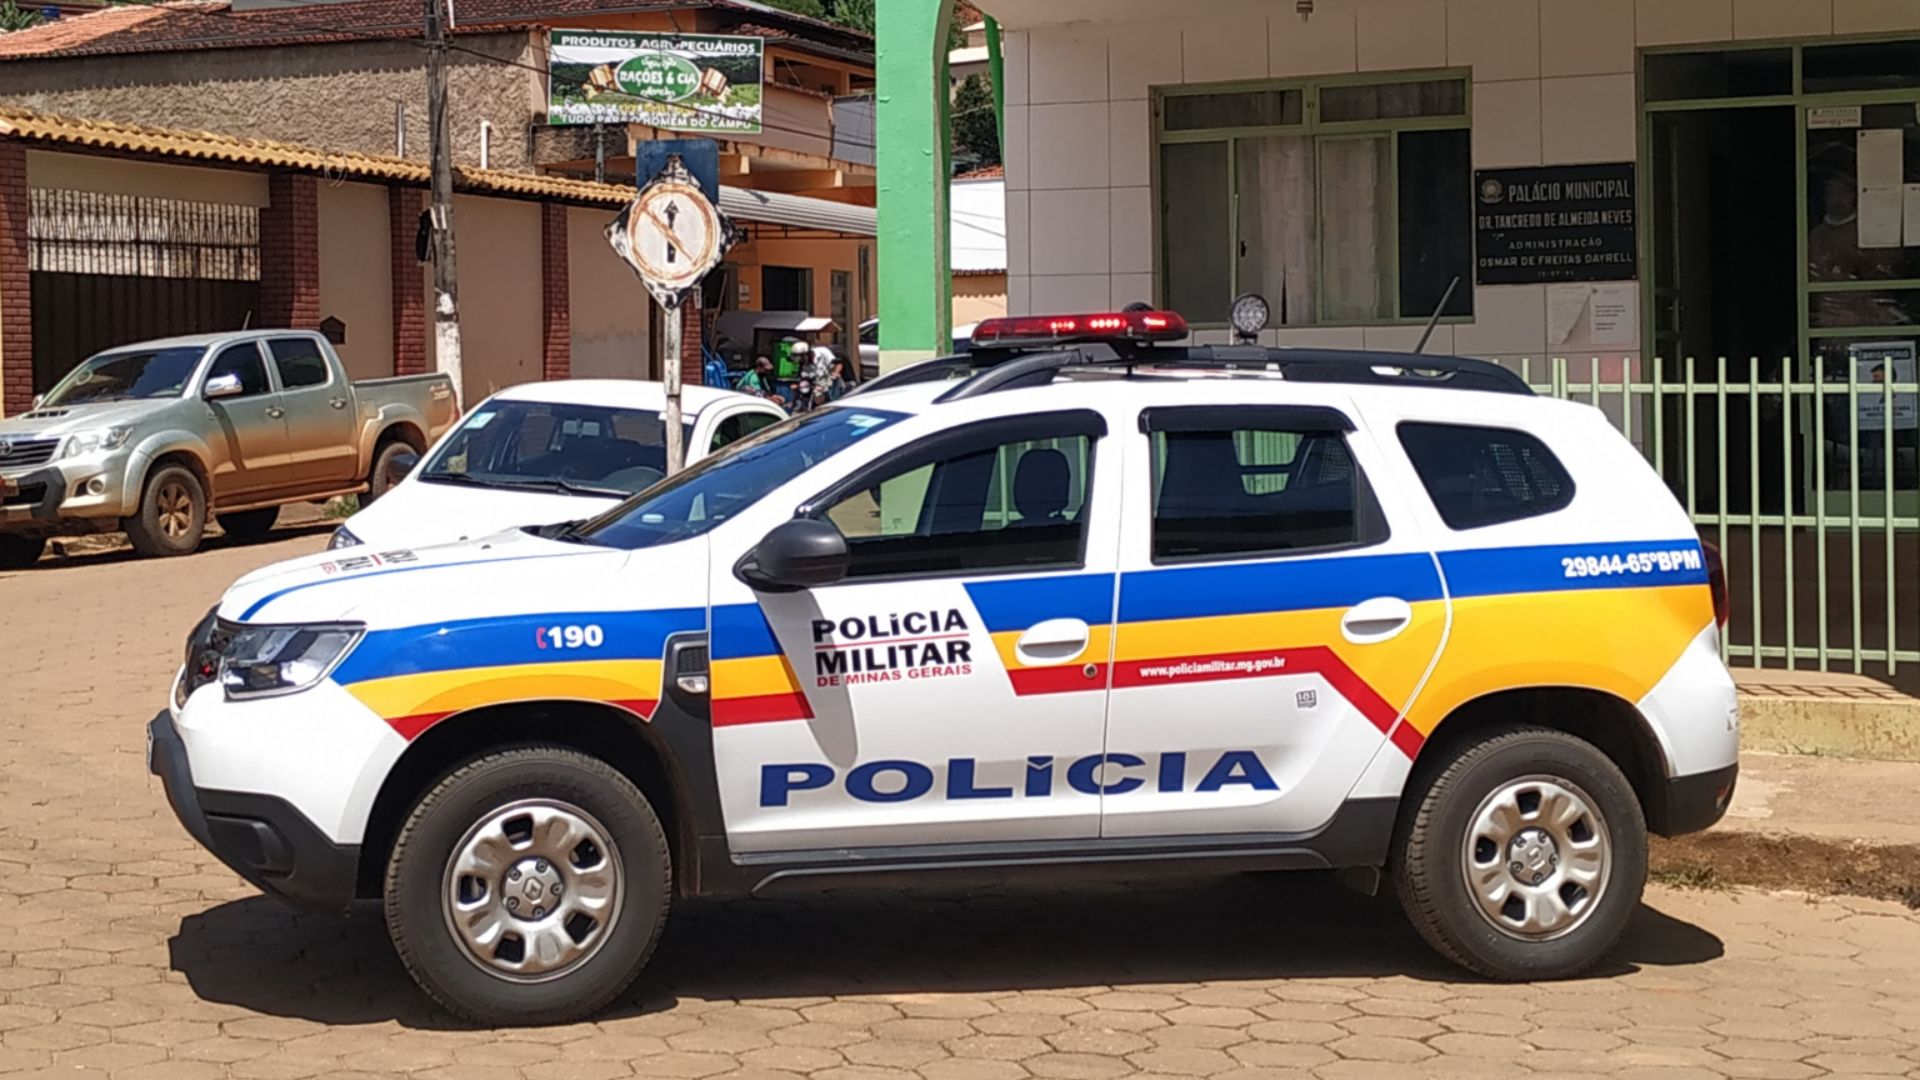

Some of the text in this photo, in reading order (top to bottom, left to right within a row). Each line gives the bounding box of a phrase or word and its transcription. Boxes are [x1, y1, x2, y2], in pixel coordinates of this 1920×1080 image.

[561, 35, 636, 48] PRODUTOS
[619, 68, 663, 87] RAÇÕES
[677, 73, 696, 84] CIA
[561, 113, 595, 123] TUDO
[643, 115, 687, 126] HOMEM
[690, 118, 707, 127] DO
[710, 119, 752, 129] CAMPO
[1508, 179, 1631, 203] PALÁCIO MUNICIPAL
[1495, 213, 1542, 229] TANCREDO
[1543, 212, 1557, 227] DE
[1558, 211, 1600, 226] ALMEIDA
[1600, 209, 1632, 225] NEVES
[1508, 237, 1603, 250] ADMINISTRAÇÃO
[1479, 252, 1633, 268] OSMAR DE FREITAS DAYRELL
[547, 624, 604, 649] 190
[812, 608, 969, 643] POLÍCIA
[815, 640, 972, 676] MILITAR
[1139, 655, 1286, 678] www.policiamilitar.mg.gov.br
[817, 664, 972, 687] DE MINAS GERAIS
[759, 749, 1282, 807] POLÍCIA
